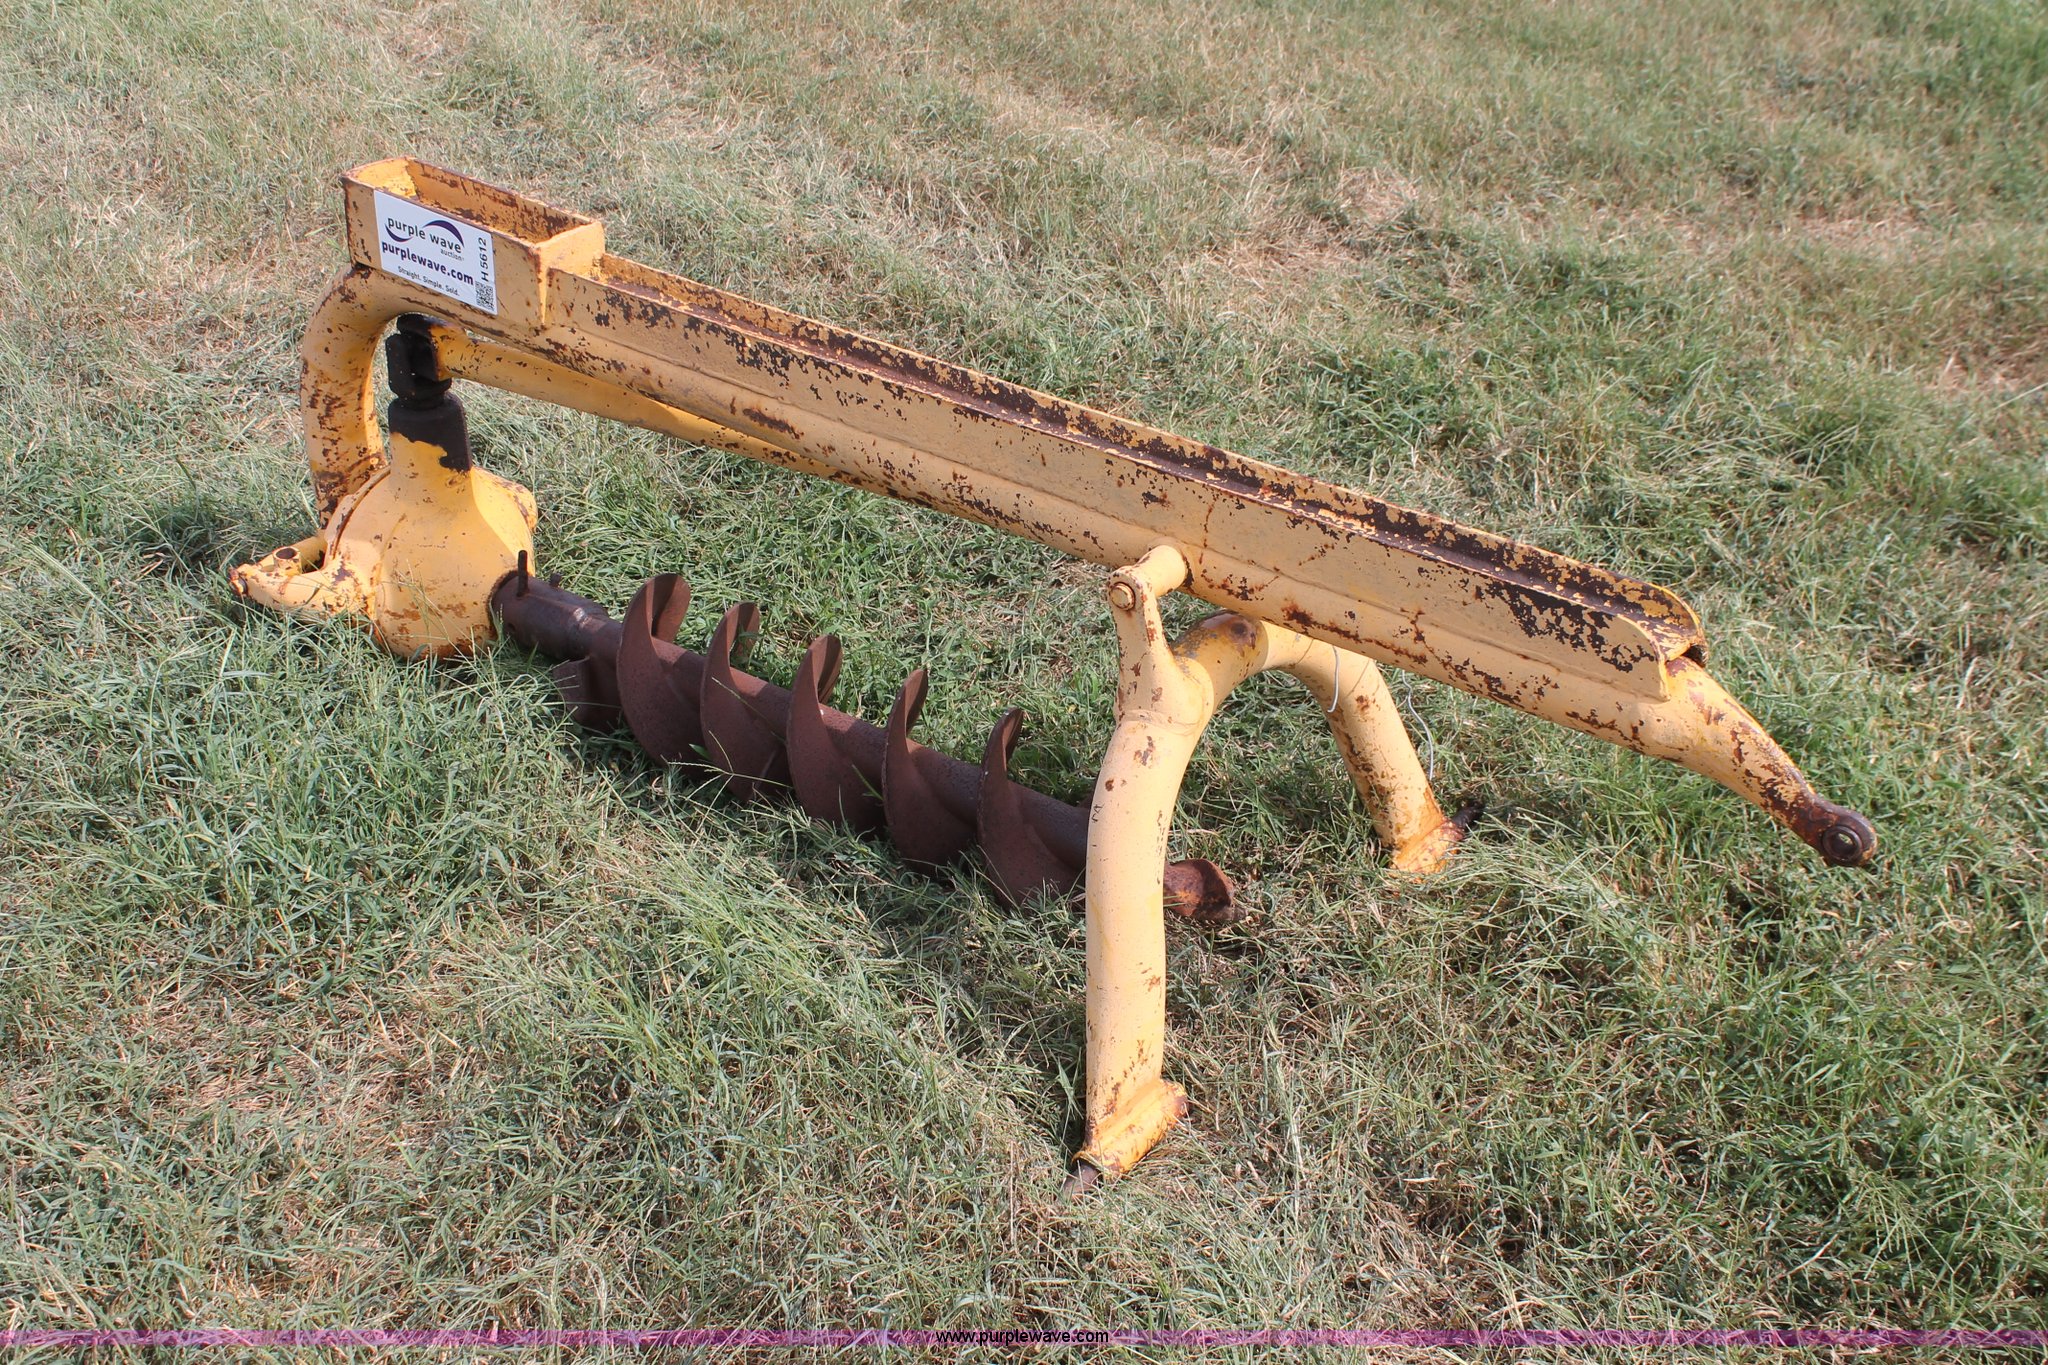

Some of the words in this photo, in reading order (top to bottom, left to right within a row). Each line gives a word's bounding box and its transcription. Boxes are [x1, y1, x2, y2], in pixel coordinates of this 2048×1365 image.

[388, 217, 426, 239] purple
[429, 233, 462, 253] wave
[381, 241, 474, 286] purplewave.com
[398, 266, 422, 280] Straight.
[423, 276, 444, 290] Simple.
[445, 285, 460, 296] Sold.
